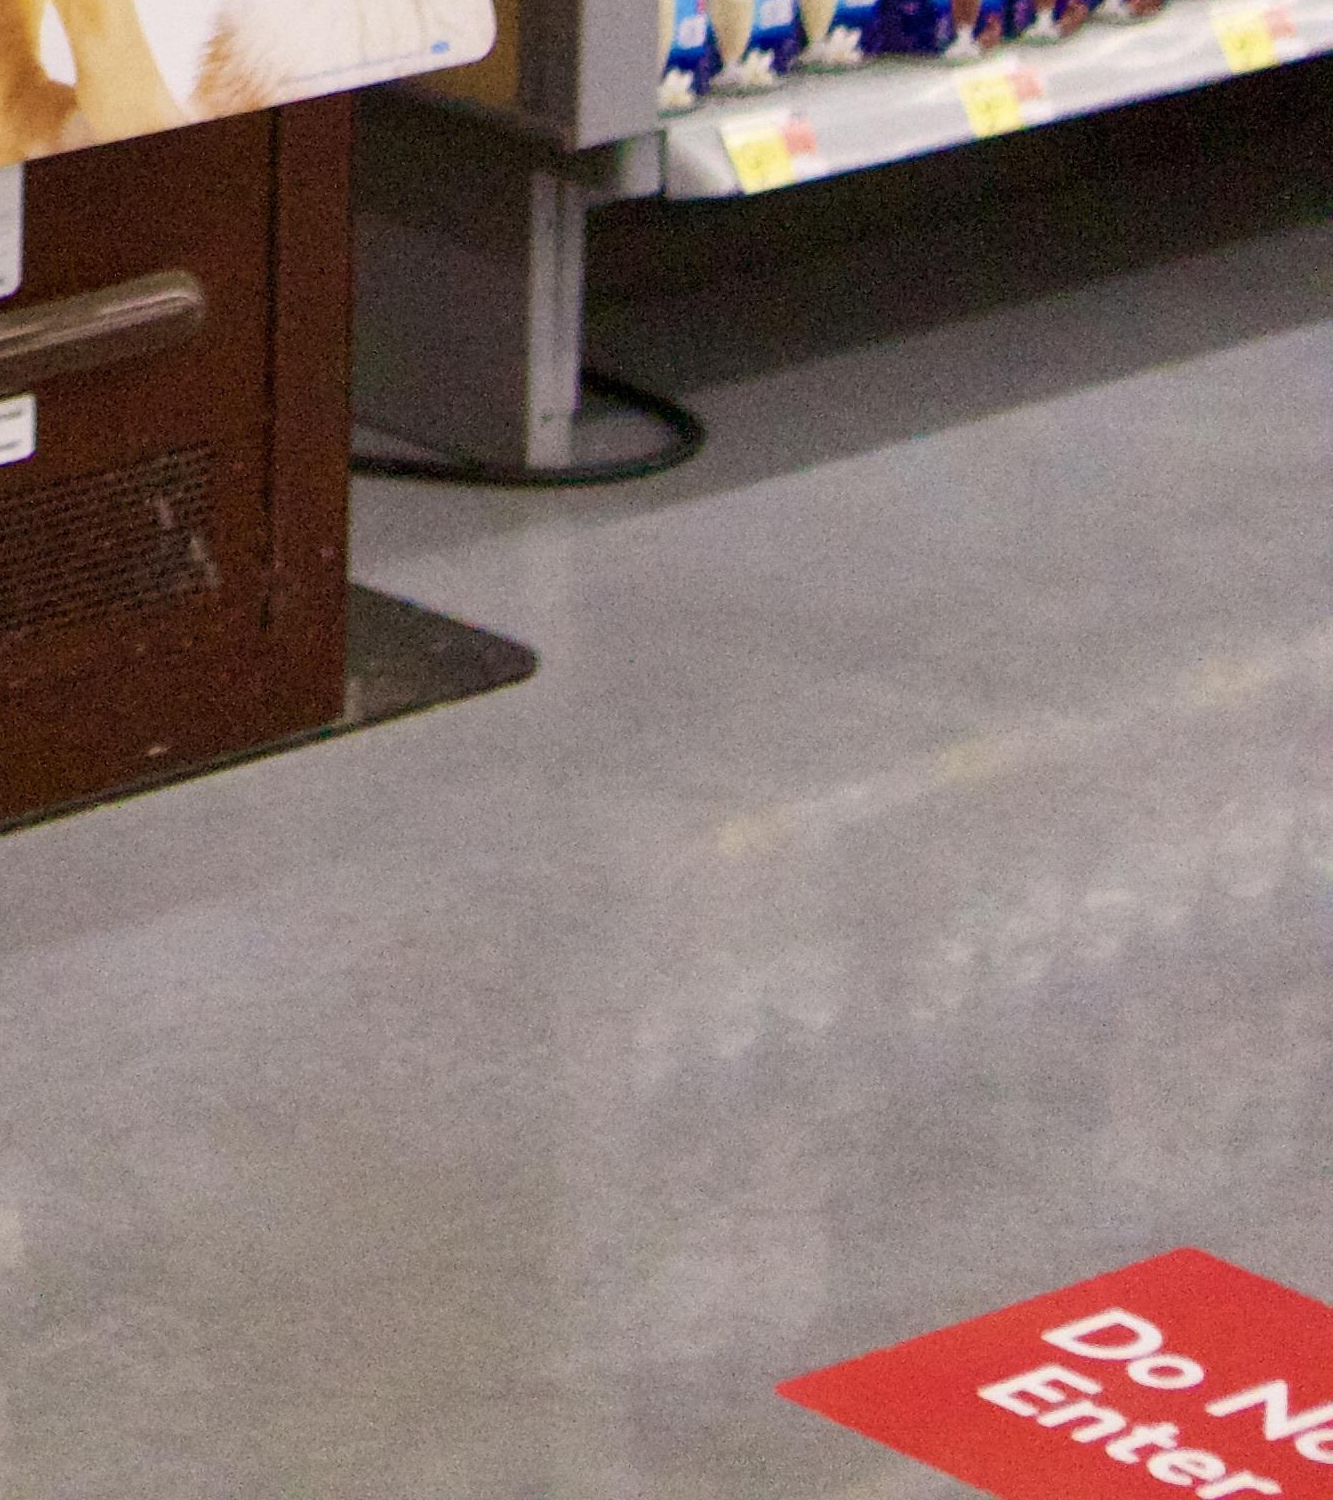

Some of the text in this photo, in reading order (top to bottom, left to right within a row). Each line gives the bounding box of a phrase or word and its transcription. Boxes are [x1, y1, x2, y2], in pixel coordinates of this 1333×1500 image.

[1041, 1307, 1205, 1390] Do
[977, 1364, 1283, 1500] Enter
[1205, 1379, 1333, 1465] No
